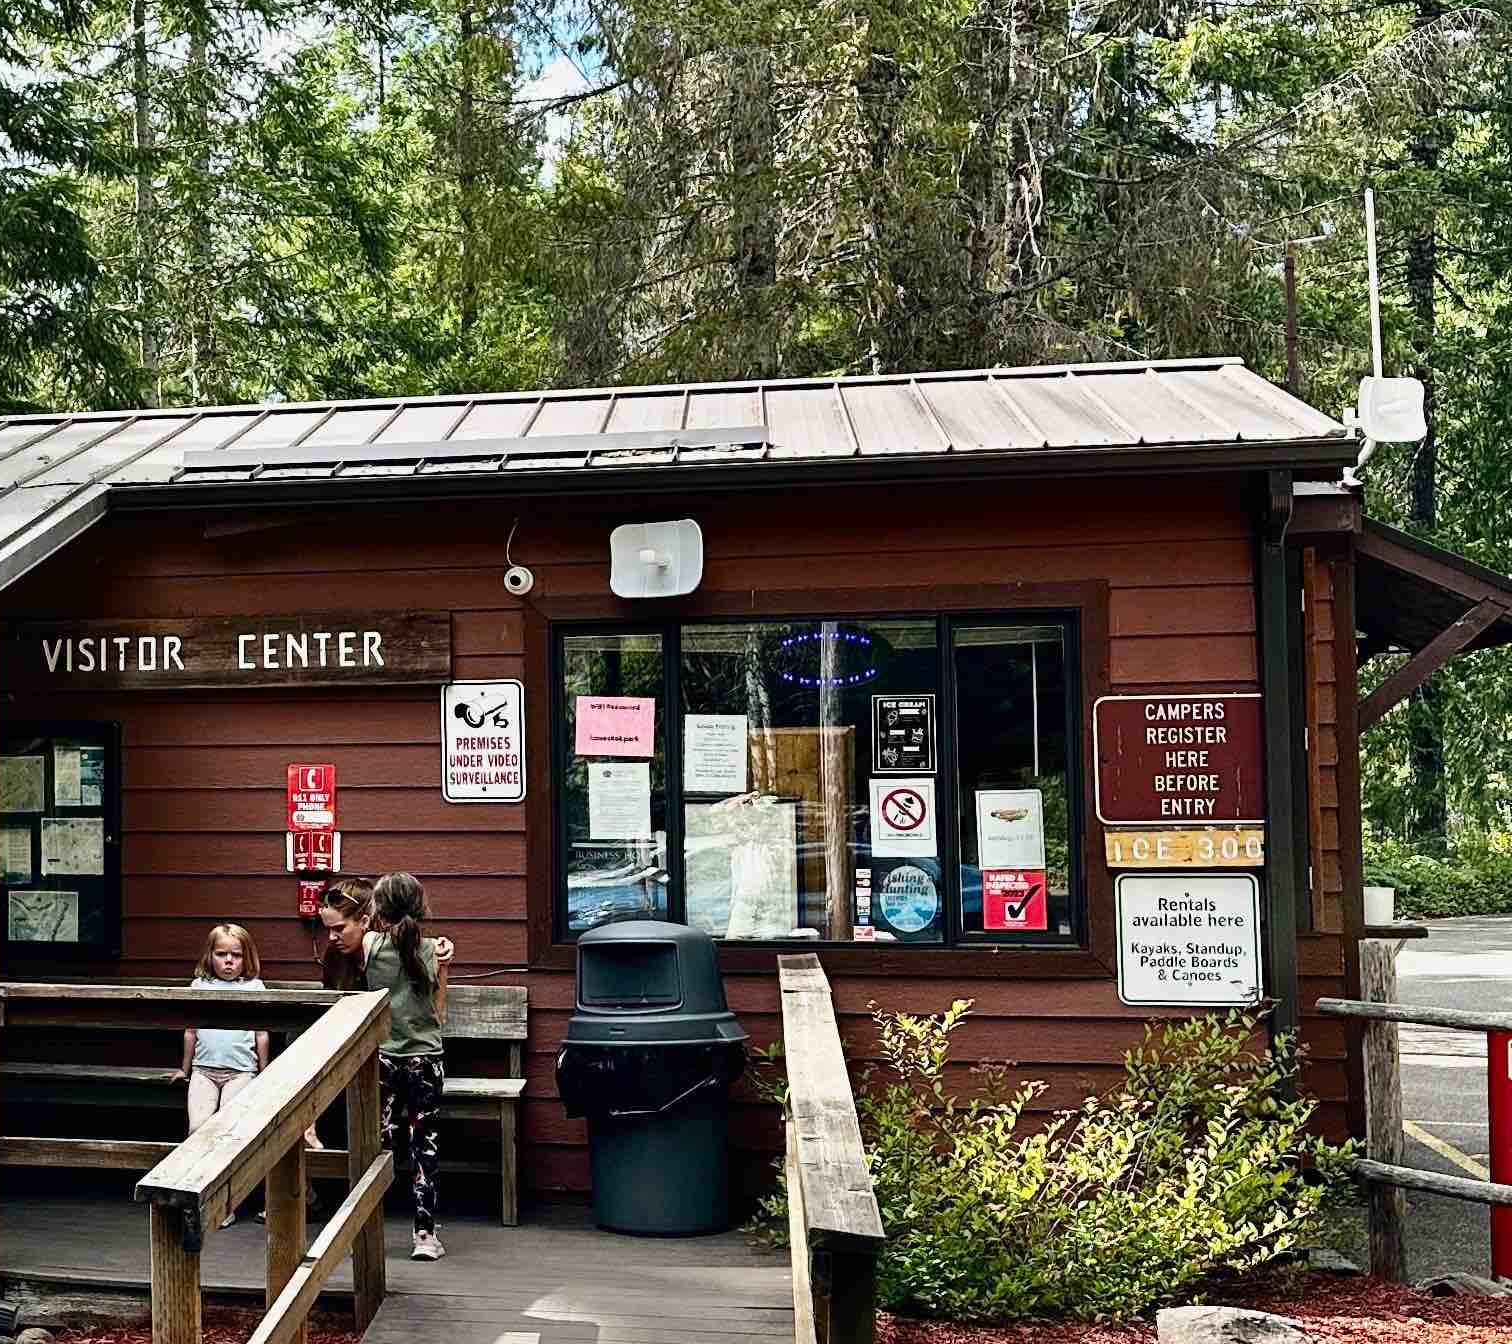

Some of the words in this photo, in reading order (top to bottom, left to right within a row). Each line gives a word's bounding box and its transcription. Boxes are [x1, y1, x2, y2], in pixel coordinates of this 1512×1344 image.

[42, 636, 185, 672] VISITOR
[237, 631, 385, 669] CENTER
[1144, 702, 1225, 721] CAMPERS
[1145, 726, 1228, 744] REGISTER
[455, 736, 511, 750] PREMISES
[449, 754, 483, 768] UNDER
[487, 752, 518, 767] VIDEO
[1164, 750, 1209, 768] HERE
[449, 771, 519, 785] SURVEILLANCE
[1154, 774, 1220, 792] BEFORE
[309, 793, 330, 802] ONLY
[297, 802, 326, 811] PHONE
[1160, 798, 1216, 816] ENTRY
[1114, 837, 1172, 863] ICE
[1158, 897, 1216, 912] Rentals
[1132, 913, 1202, 927] available
[1208, 913, 1244, 927] here
[1131, 942, 1182, 956] Kayaks,
[1186, 942, 1247, 957] Standup,
[1140, 956, 1187, 968] Paddle
[1191, 956, 1239, 968] Boards
[1157, 969, 1167, 981] &
[1172, 969, 1222, 982] Canoes
